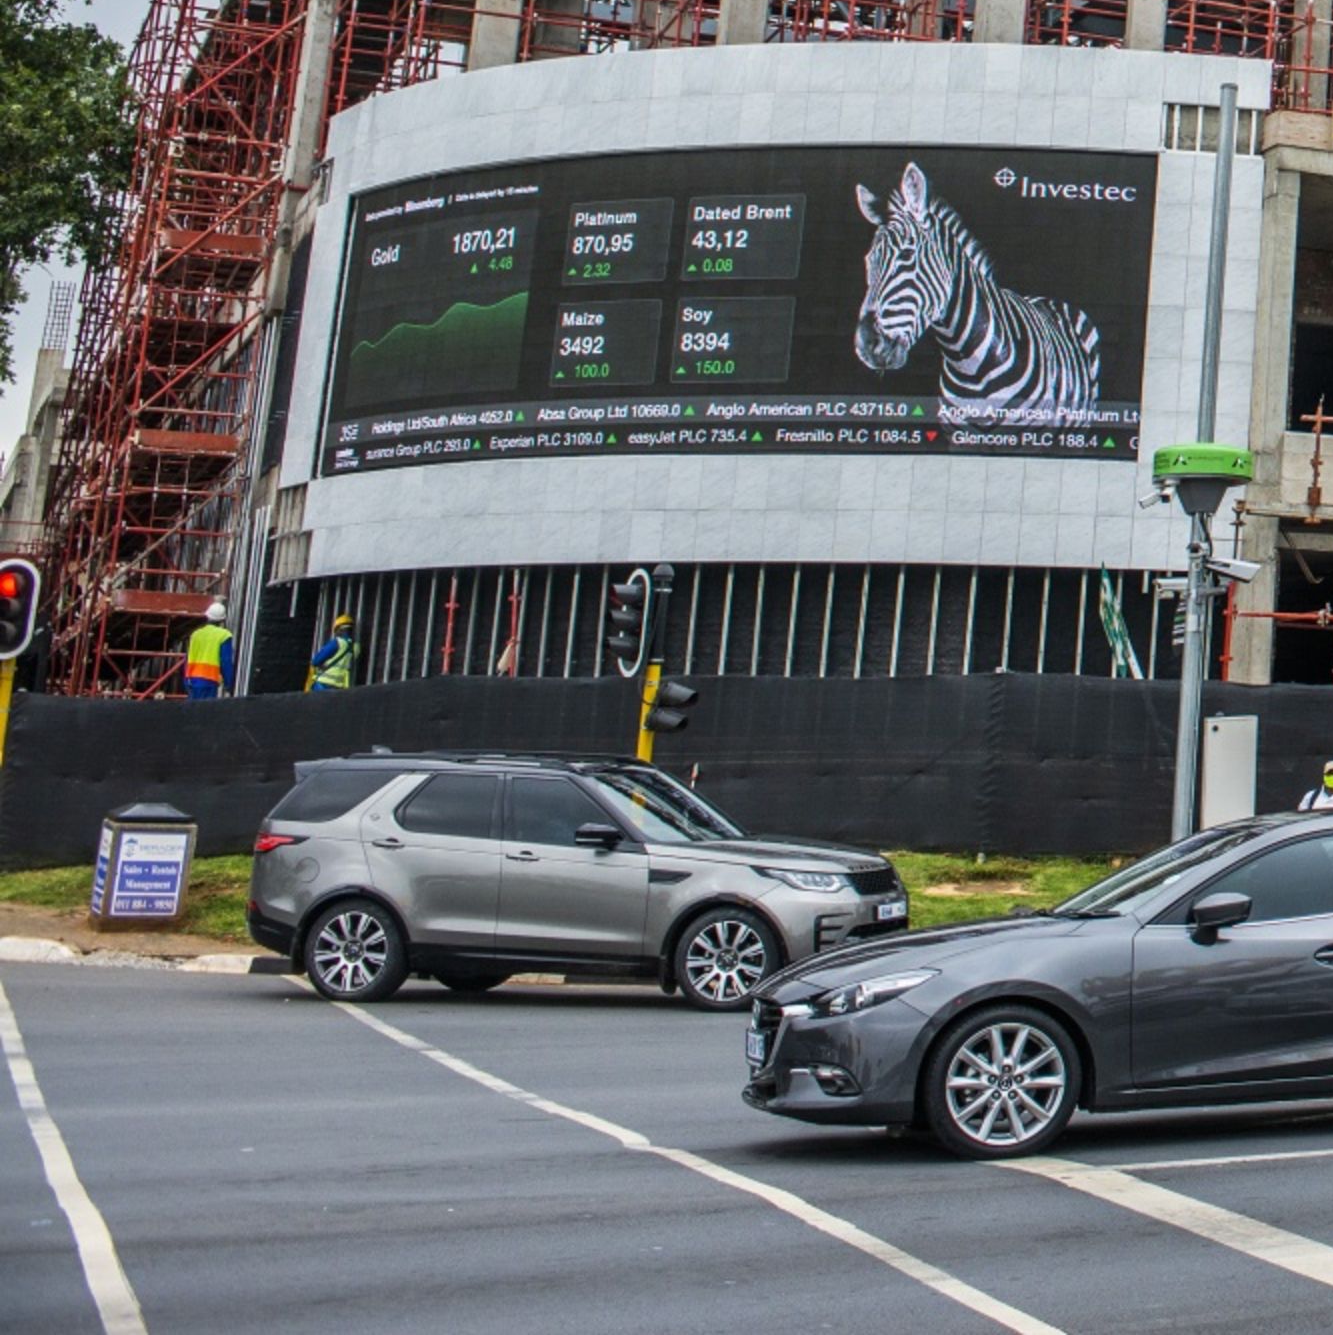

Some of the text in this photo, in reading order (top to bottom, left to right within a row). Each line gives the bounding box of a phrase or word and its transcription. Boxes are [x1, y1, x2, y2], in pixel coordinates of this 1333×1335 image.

[1021, 176, 1137, 202] Investec
[574, 211, 637, 228] Platinum
[693, 204, 792, 221] Dated Brent
[452, 226, 516, 254] 1870,21
[572, 233, 634, 256] 870,95
[691, 230, 749, 252] 43,12
[371, 244, 400, 266] Gold
[488, 256, 514, 271] 4.48
[583, 263, 611, 278] 2.32
[703, 258, 733, 273] 0.08
[561, 312, 605, 327] Maize
[682, 307, 713, 325] Soy
[559, 336, 605, 356] 3492
[680, 332, 731, 352] 8394
[574, 363, 610, 378] 100.0
[695, 360, 735, 375] 150.0
[449, 413, 476, 427] Africa
[537, 407, 565, 421] Absa
[568, 406, 604, 422] Group
[607, 405, 628, 418] Ltd
[706, 402, 746, 420] Anglo
[748, 402, 812, 416] American
[815, 402, 846, 416] PLC
[849, 402, 907, 417] 43715.0
[937, 403, 979, 420] Anglo
[983, 403, 1052, 421] American
[1057, 406, 1119, 422] Platinum
[1123, 409, 1141, 422] Lt
[396, 442, 421, 459] Group
[423, 440, 442, 454] PLC
[489, 434, 534, 451] Experian
[536, 433, 561, 447] PLC
[628, 430, 676, 447] easyJet
[679, 430, 707, 443] PLC
[710, 429, 747, 442] 735.4
[775, 428, 833, 443] Fresnillo
[837, 429, 868, 443] PLC
[873, 429, 921, 444] 1084.5
[951, 430, 1018, 445] Glencore
[1021, 432, 1053, 446] PLC
[1058, 433, 1098, 448] 188.4
